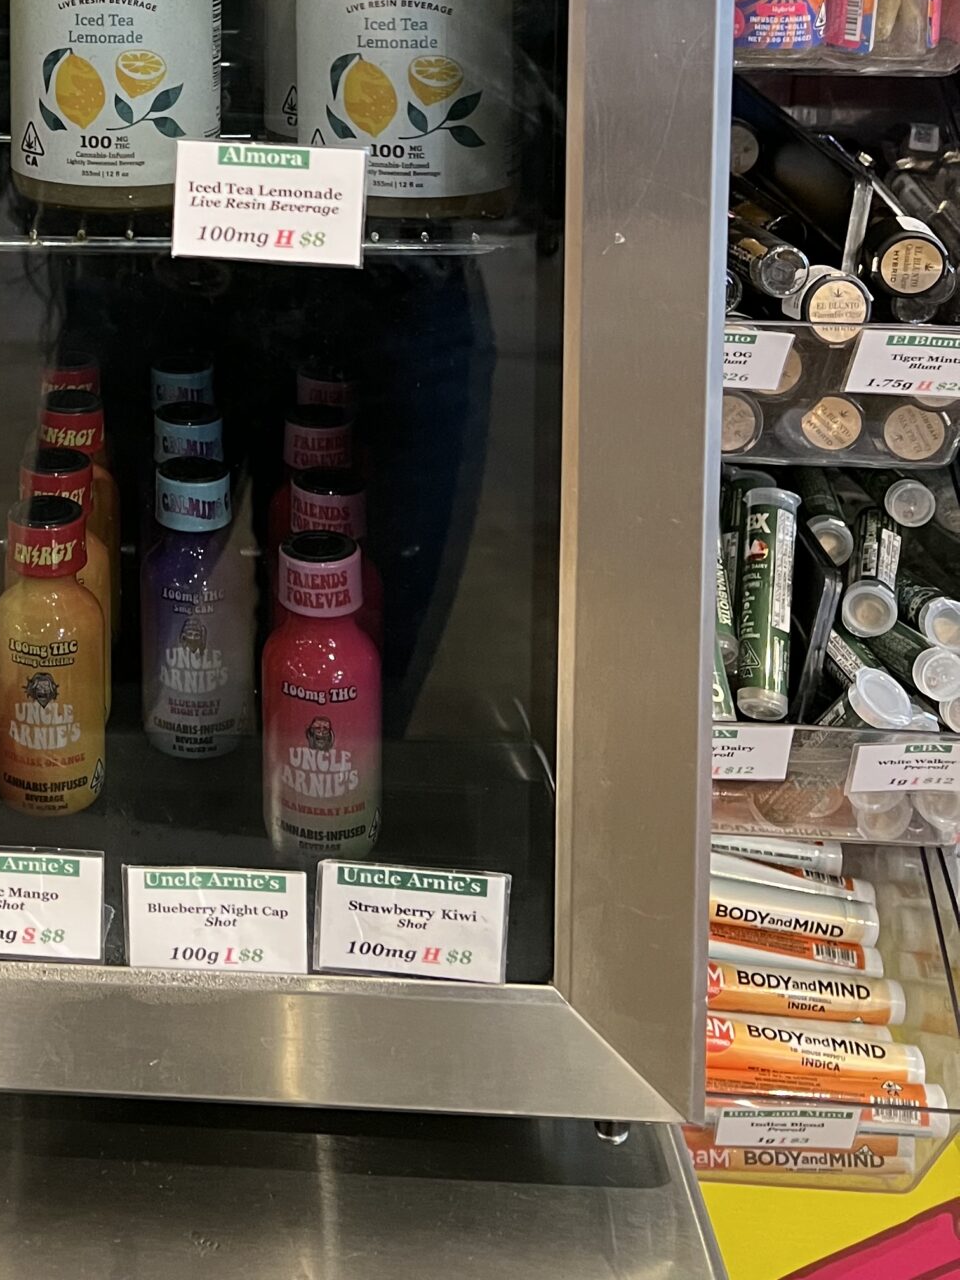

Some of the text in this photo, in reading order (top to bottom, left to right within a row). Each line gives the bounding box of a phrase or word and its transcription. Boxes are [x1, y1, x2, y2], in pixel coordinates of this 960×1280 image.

[58, 0, 76, 9] LIVE
[75, 14, 133, 26] Iced Tea
[69, 30, 142, 43] Lemonade
[81, 136, 111, 148] 100
[221, 147, 304, 166] Almora
[190, 181, 342, 200] Iced Tea Lemonade
[191, 196, 339, 216] Live Resin Beverage
[199, 226, 325, 247] 100mg H $8
[891, 353, 924, 362] Tiger
[867, 379, 913, 390] 1.75g
[286, 571, 348, 588] FRIENDS
[286, 589, 352, 609] FOREVER
[15, 703, 74, 721] UNCLE
[9, 722, 81, 751] ARNIE'S
[721, 745, 755, 753] Dairy
[909, 745, 946, 753] CBX
[9, 888, 58, 901] Mango
[148, 903, 288, 919] Blueberry Night Cap
[349, 901, 476, 921] Strawberry Kiwi
[736, 970, 870, 1000] BODYandMIND
[787, 1001, 826, 1013] INDICA
[747, 1025, 886, 1059] BODYandMIND
[801, 1057, 841, 1072] INDICA
